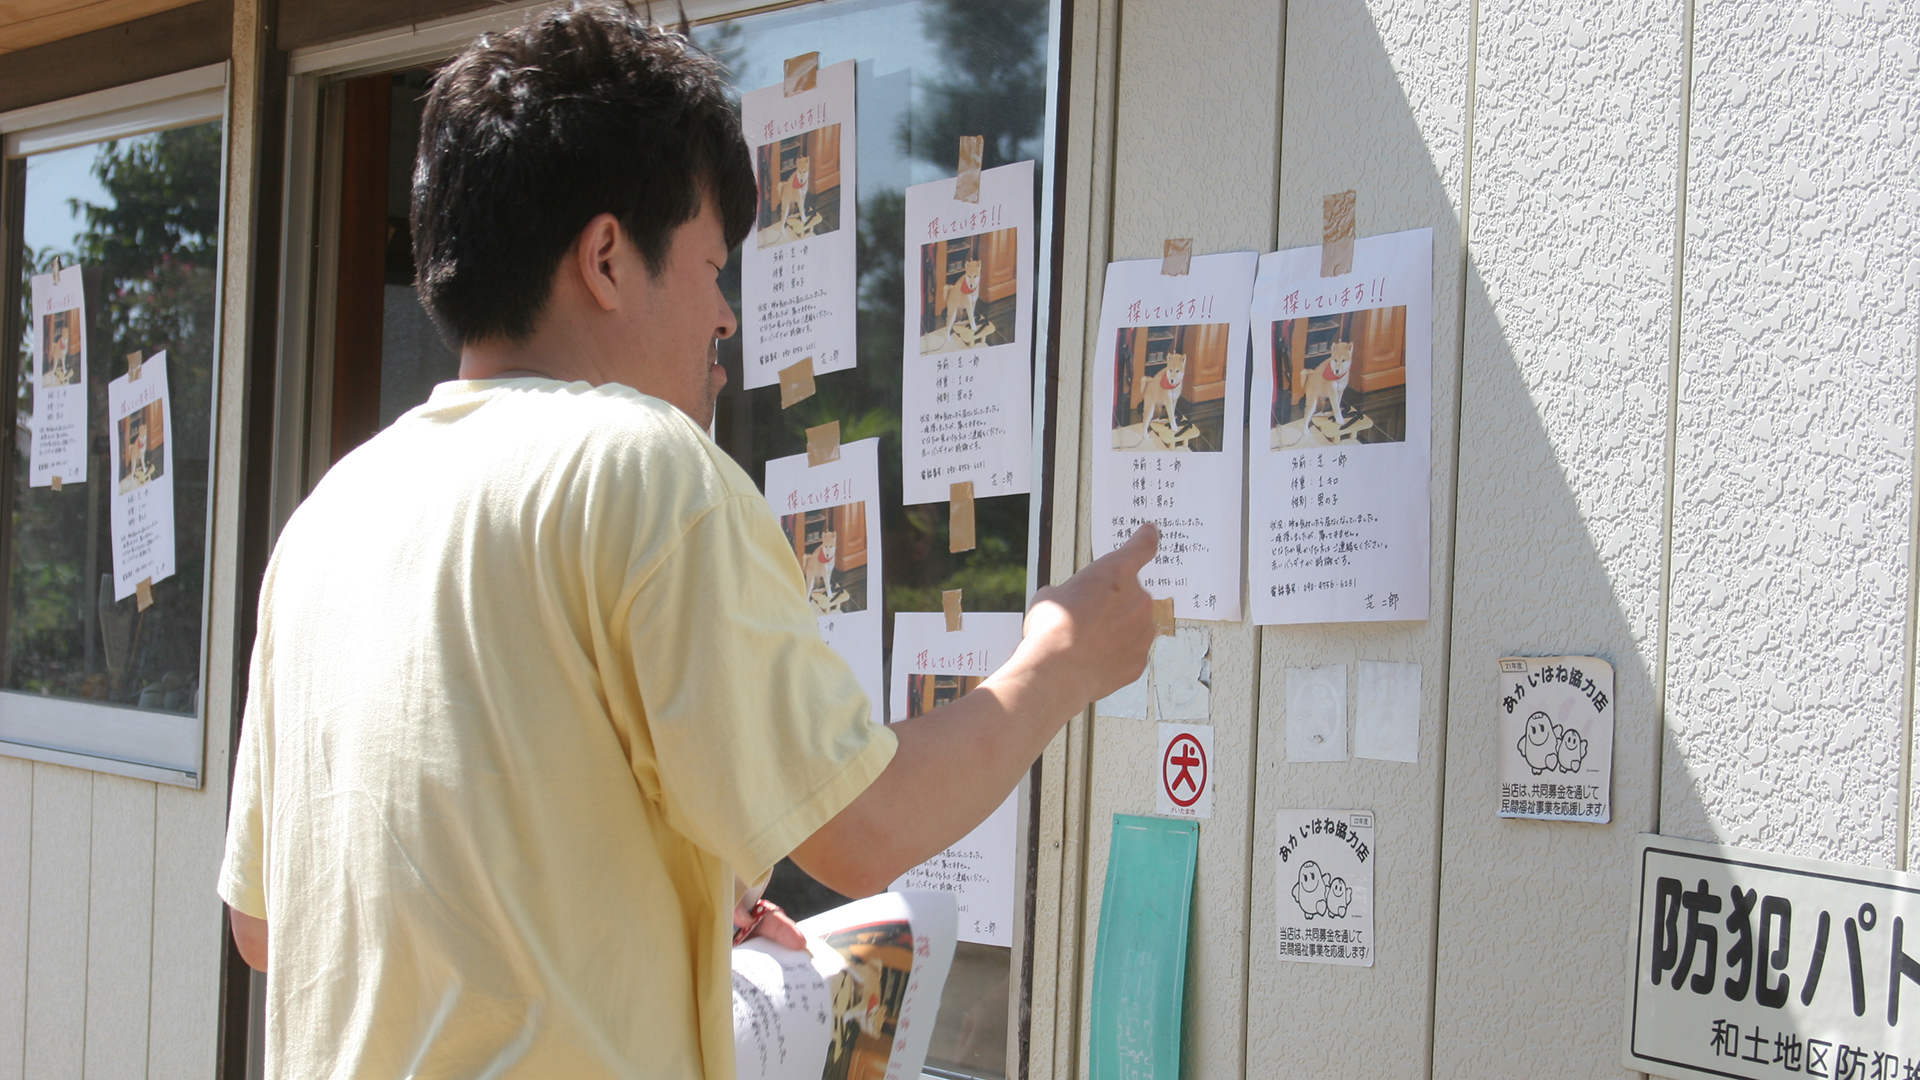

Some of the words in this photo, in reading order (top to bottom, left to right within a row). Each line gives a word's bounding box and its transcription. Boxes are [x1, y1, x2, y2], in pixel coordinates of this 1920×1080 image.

[928, 204, 1001, 239] 探しています!!
[1127, 295, 1214, 322] 探しています!!
[1283, 278, 1386, 315] 探しています!!
[787, 479, 852, 510] 探しています!!
[916, 649, 989, 671] 探しています!!
[1502, 664, 1609, 714] あかいはね協力店
[1170, 743, 1200, 793] 犬
[1500, 799, 1606, 817] 民間福祉事業を応援します!
[1502, 783, 1599, 800] 当店は、共同募金を通じて
[1279, 817, 1370, 863] あかいはね協力店
[1280, 926, 1363, 944] 当店は、共同募金を通じて
[1280, 941, 1370, 960] 民間福祉事業を応援します!
[1651, 876, 1920, 1027] 防犯パト
[1710, 1019, 1920, 1080] 和土地区防犯
